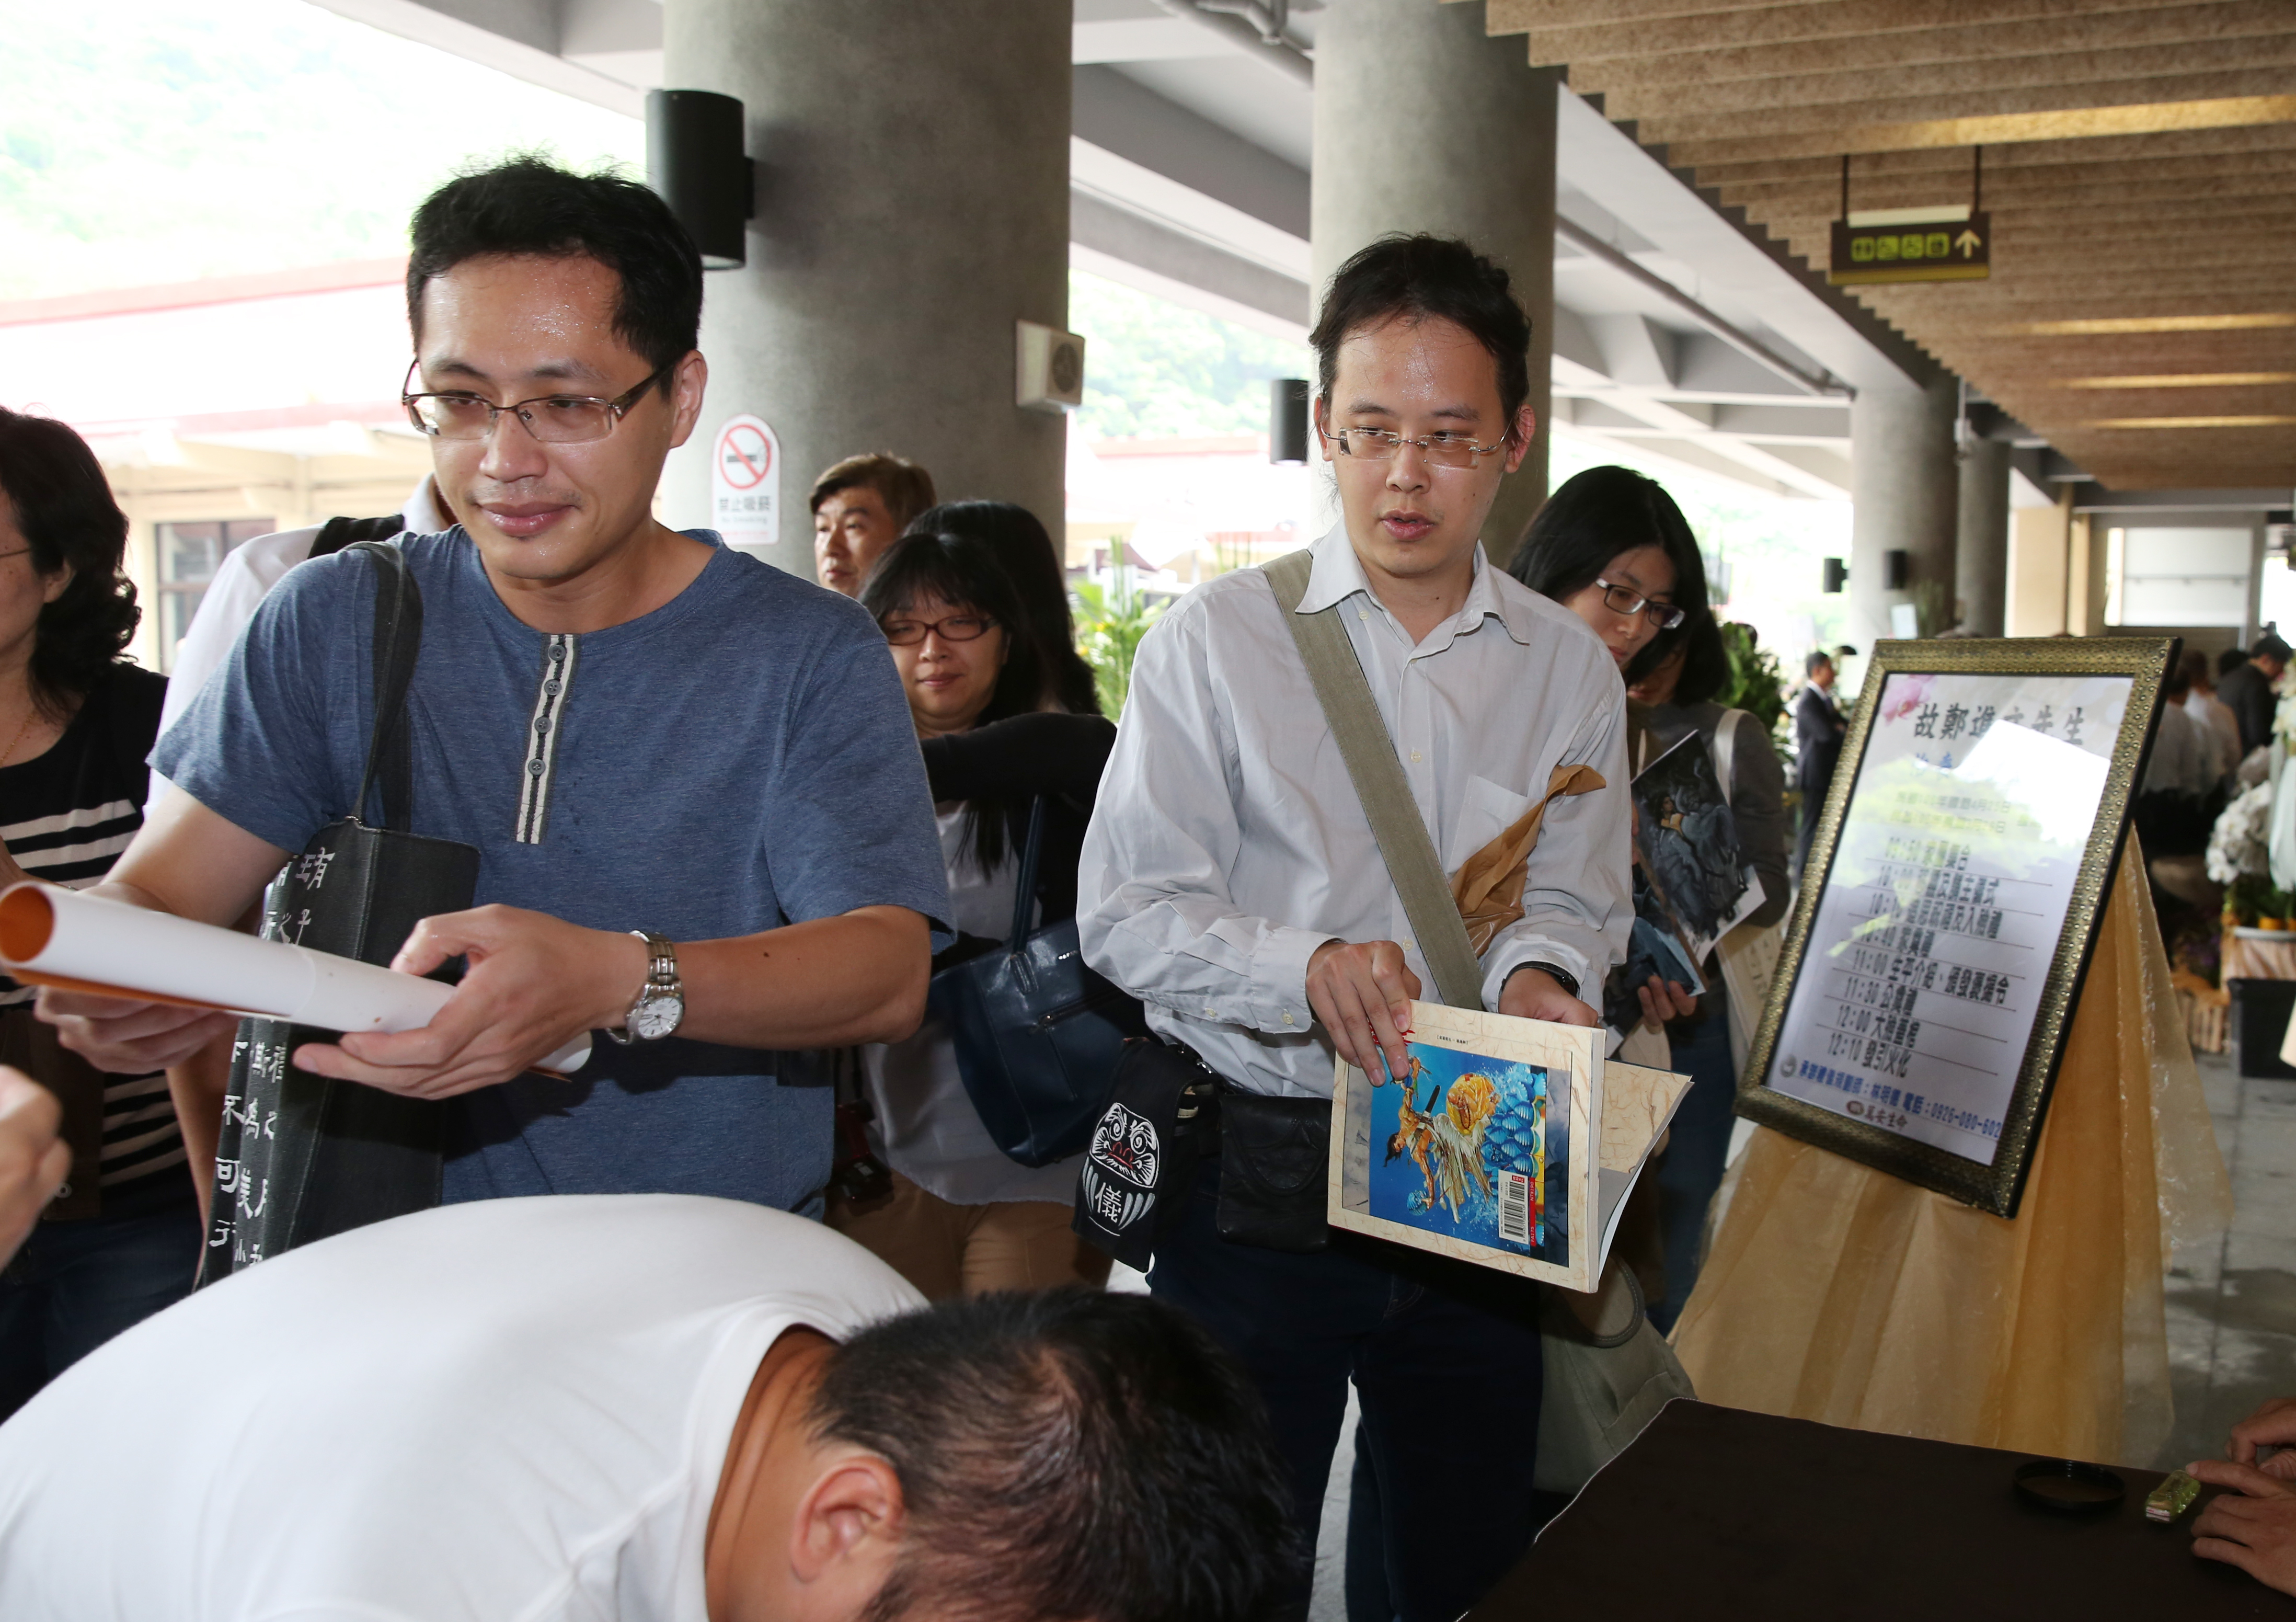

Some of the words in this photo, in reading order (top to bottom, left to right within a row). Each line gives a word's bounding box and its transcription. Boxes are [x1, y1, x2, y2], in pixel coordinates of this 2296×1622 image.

[1853, 949, 1888, 976] 11:00
[1845, 978, 1880, 1004] 11:30
[1836, 1005, 1872, 1033] 12:00
[1828, 1033, 1863, 1062] 12:10
[1095, 1182, 1122, 1223] 儀
